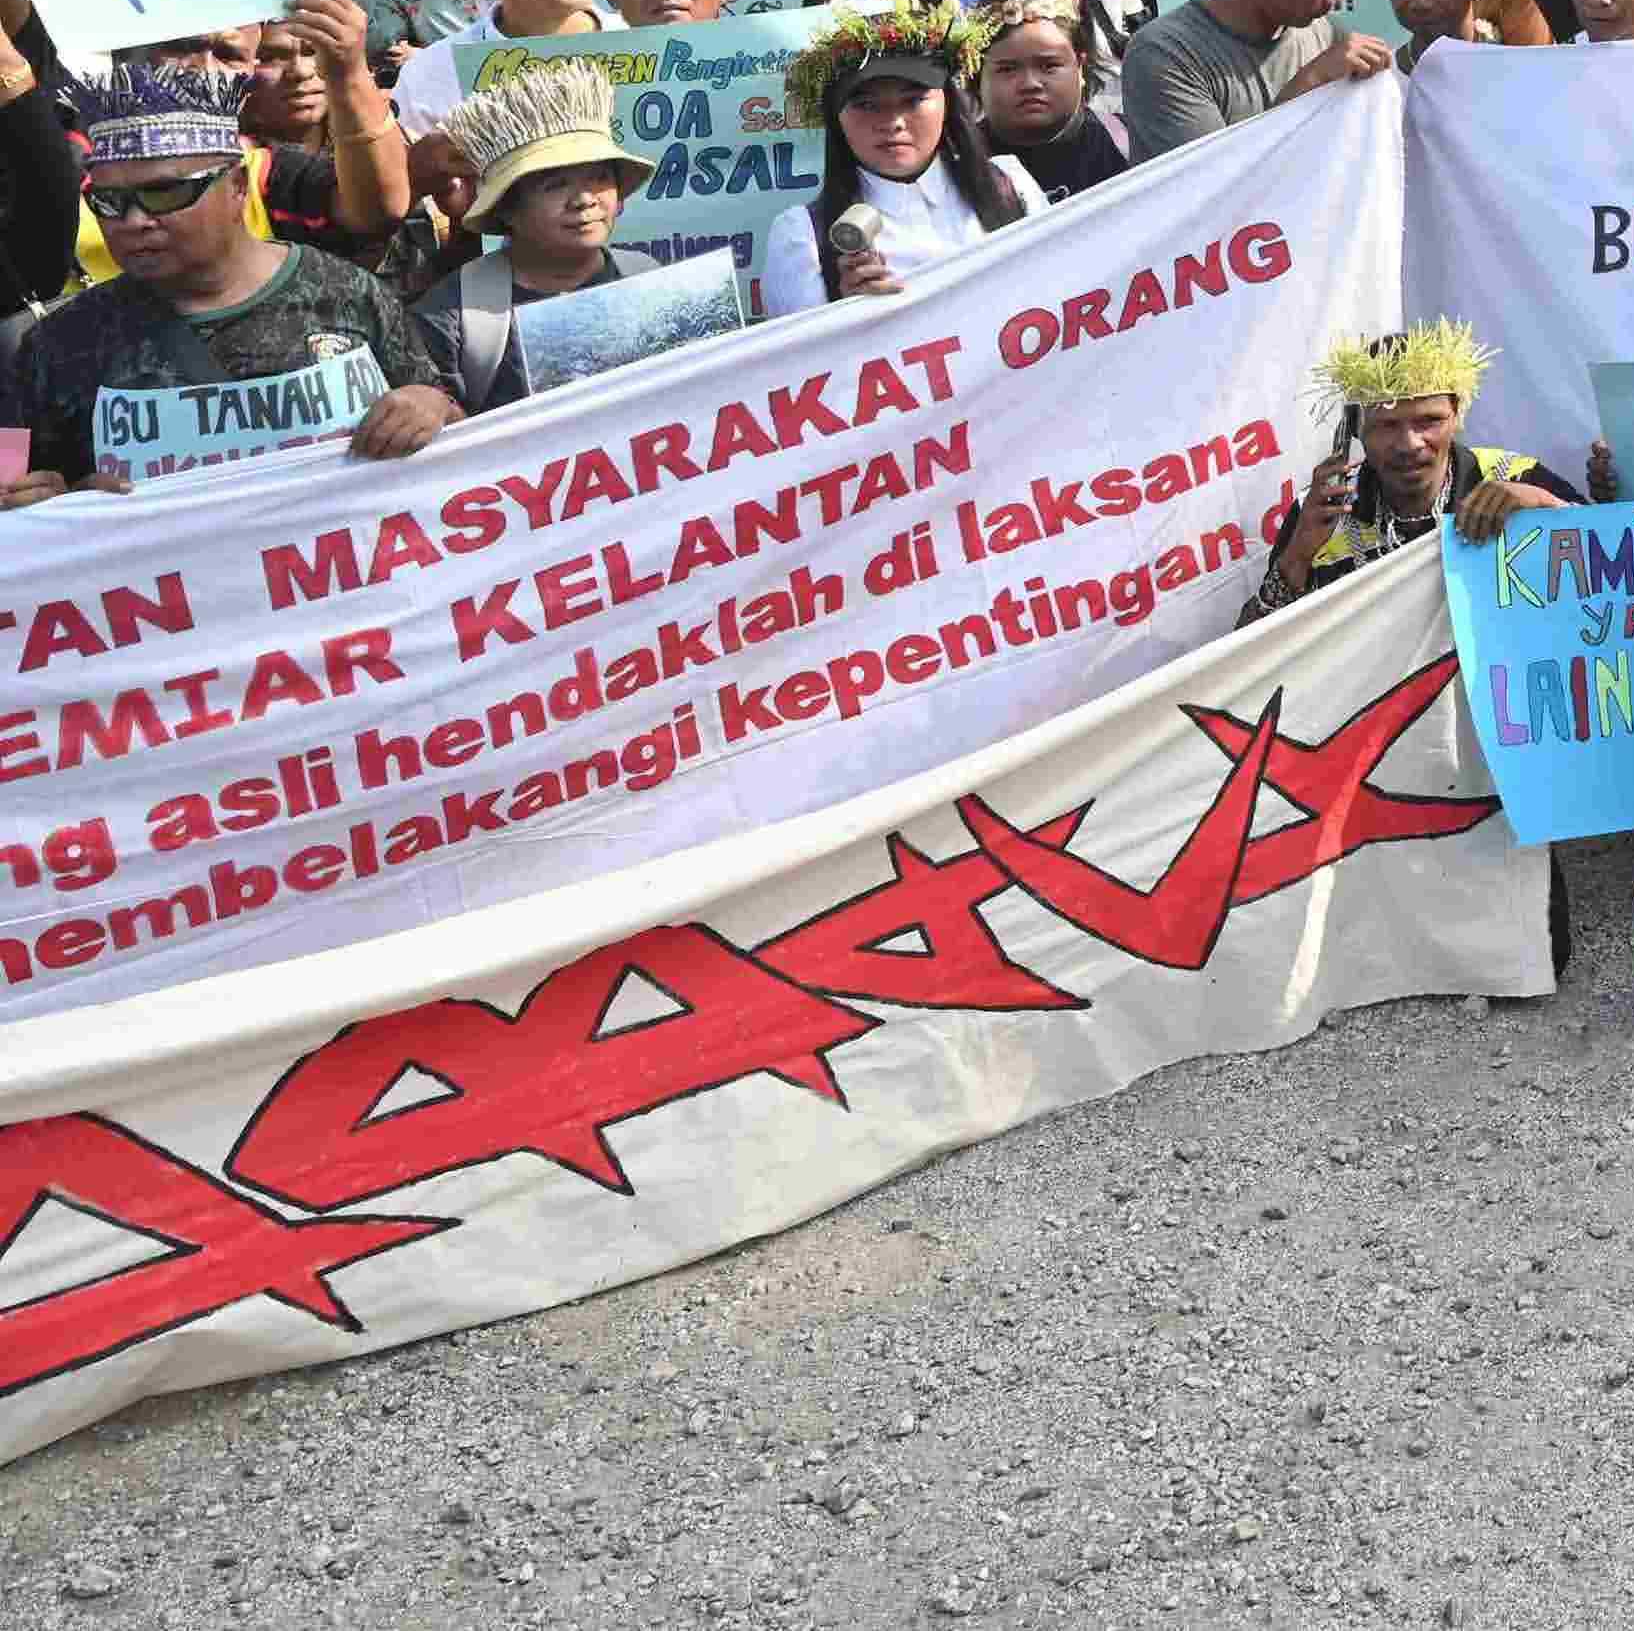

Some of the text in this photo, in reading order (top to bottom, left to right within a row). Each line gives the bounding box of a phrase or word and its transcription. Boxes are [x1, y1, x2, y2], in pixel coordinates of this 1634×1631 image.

[632, 89, 713, 141] OA
[646, 141, 820, 201] ASAL
[100, 368, 330, 446] ISU TANAH
[258, 219, 1293, 611] MASYARAKAT ORANG
[144, 417, 1282, 852] asli hendaklah di laksana
[450, 419, 974, 662] KELANTAN
[718, 521, 1249, 742] kepentingan
